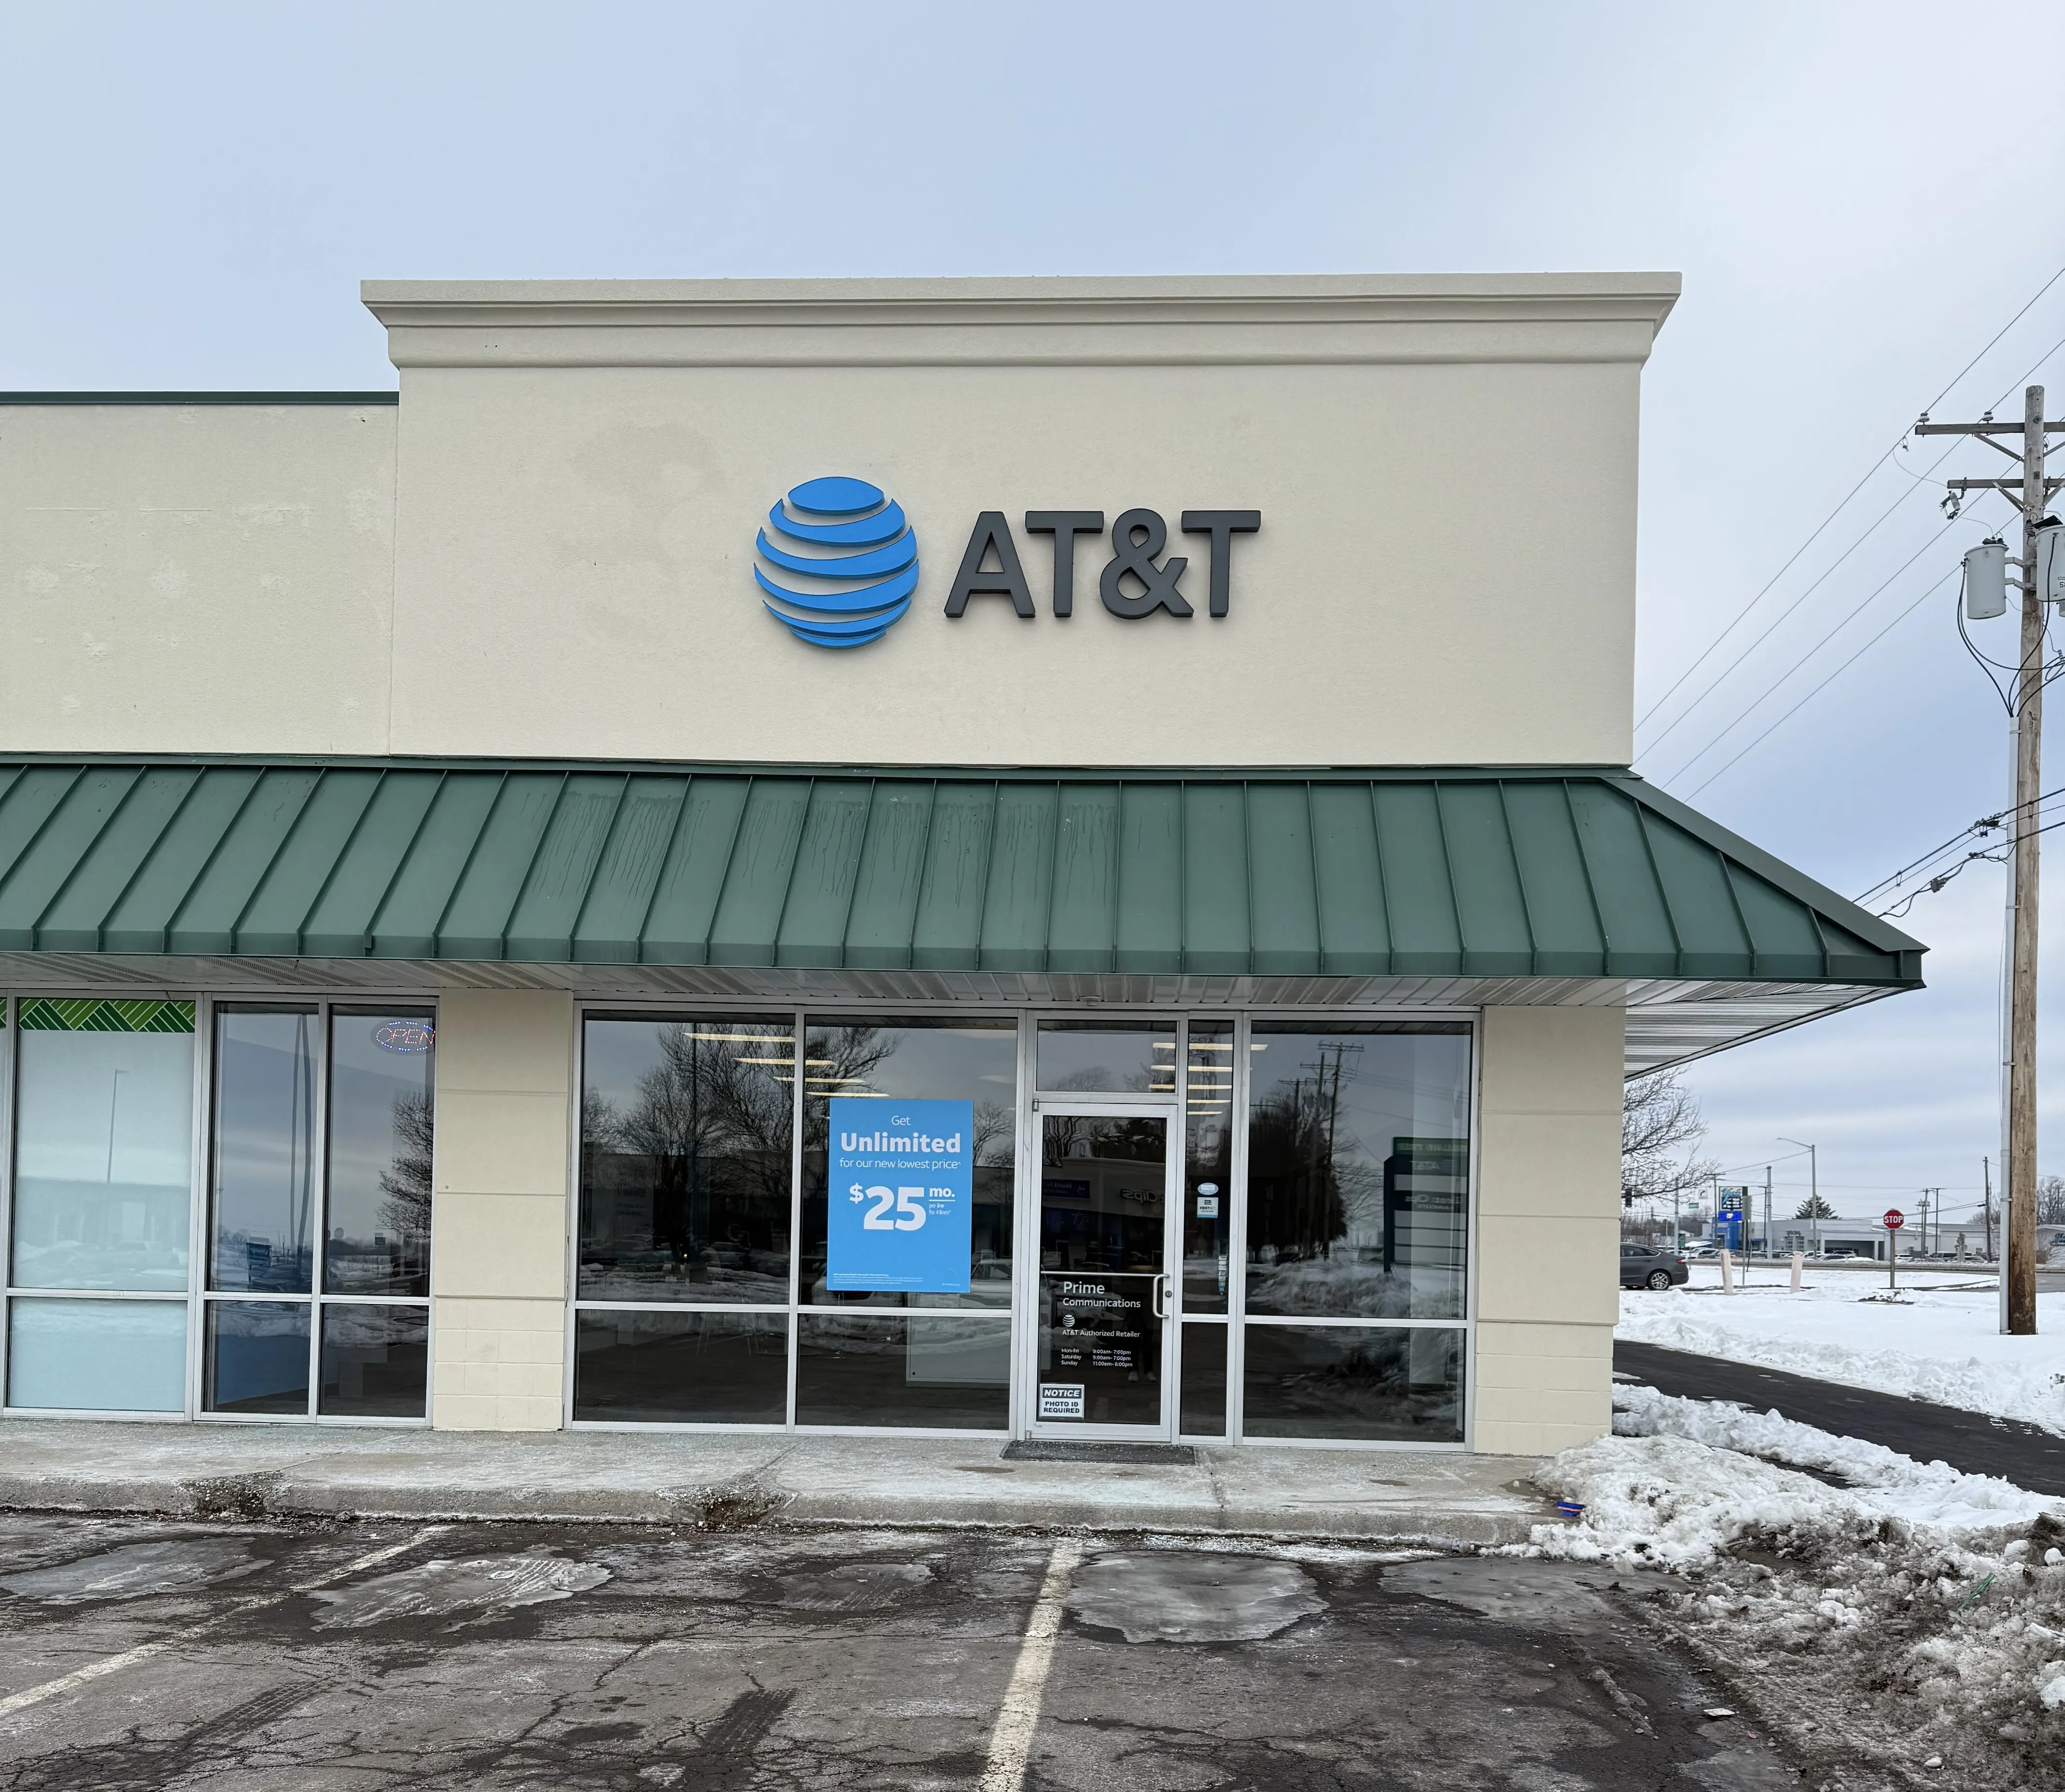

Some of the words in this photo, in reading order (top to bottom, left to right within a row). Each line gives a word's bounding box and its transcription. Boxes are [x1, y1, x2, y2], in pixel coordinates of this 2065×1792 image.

[943, 508, 1261, 620] AT&T
[376, 1027, 436, 1045] OPEN
[891, 1115, 911, 1126] Get
[841, 1132, 961, 1153] Unlimited
[839, 1158, 855, 1168] for
[856, 1160, 872, 1168] our
[898, 1159, 930, 1169] lowest
[929, 1187, 955, 1198] mo.
[1884, 1215, 1903, 1224] STOP
[1063, 1281, 1105, 1294] Prime
[1063, 1297, 1141, 1308] Communications
